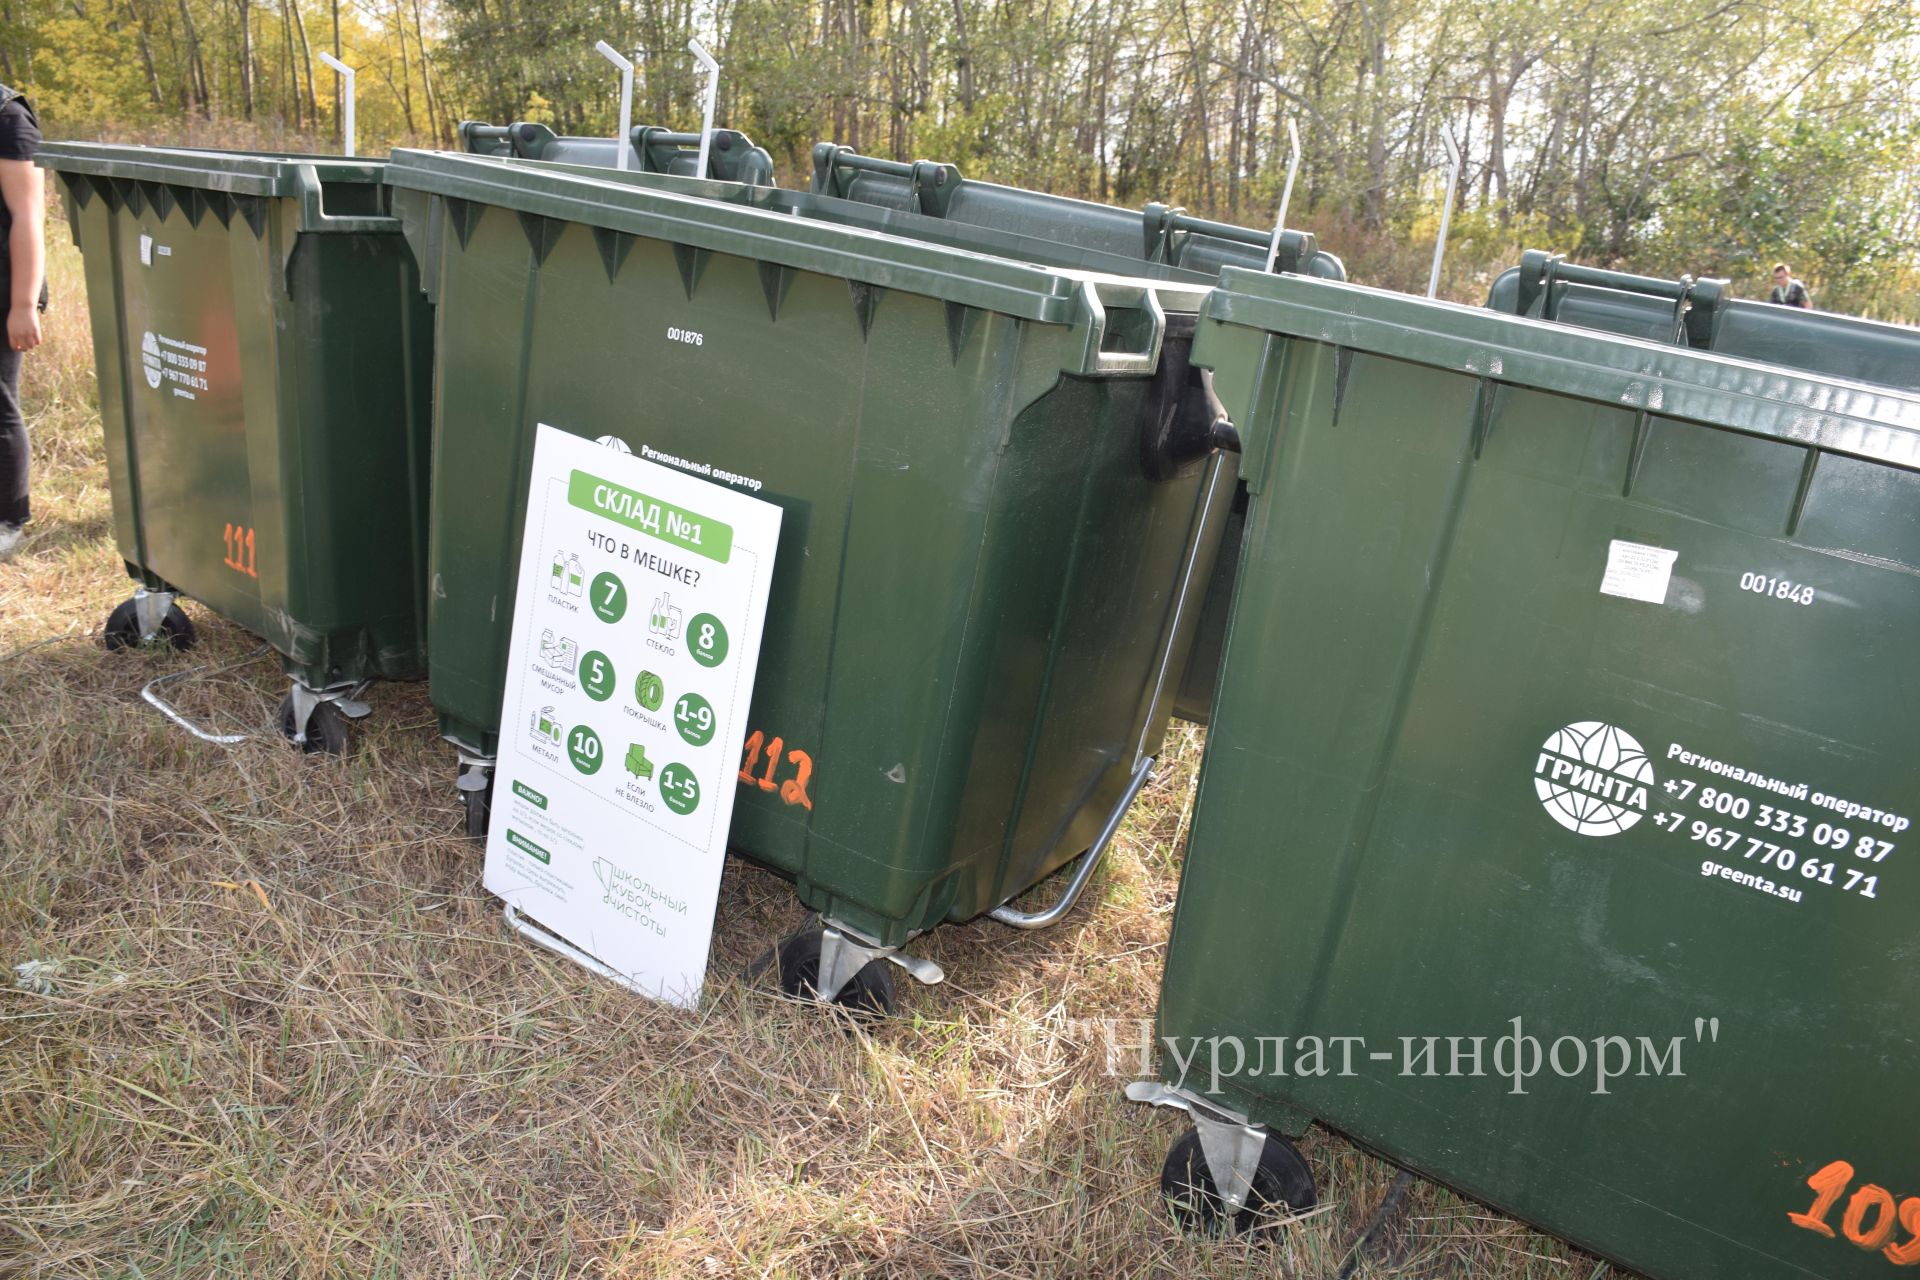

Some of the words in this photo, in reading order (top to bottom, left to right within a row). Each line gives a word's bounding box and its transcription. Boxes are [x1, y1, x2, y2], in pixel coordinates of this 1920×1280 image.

[667, 327, 704, 346] 001876
[642, 444, 711, 476] Региональный
[712, 466, 762, 492] оператор
[594, 484, 661, 534] СКЛАД
[666, 511, 702, 545] №1
[224, 522, 257, 578] 111
[588, 530, 616, 554] ЧТО
[620, 542, 629, 560] В
[634, 546, 700, 588] МЕШКЕ?
[604, 581, 618, 605] 7
[1740, 572, 1815, 606] 001848
[548, 594, 580, 614] ПЛАСТИК
[646, 638, 675, 657] СТЕКЛО
[699, 624, 715, 649] 8
[532, 663, 576, 691] СМЕШАННЫЙ
[590, 659, 604, 683] 5
[541, 680, 564, 696] МУСОР
[624, 705, 667, 732] ПОКРЫШКА
[677, 700, 712, 731] 1-9
[532, 744, 559, 764] МЕТАЛЛ
[573, 732, 598, 759] 10
[664, 770, 695, 799] 1-5
[739, 730, 813, 811] 112
[1535, 752, 1648, 811] ГРИНТА
[518, 786, 542, 805] ВАЖНО!
[616, 788, 625, 798] НЕ
[626, 792, 654, 813] ВЛЕЗЛО
[627, 782, 646, 796] ЕСЛИ
[1668, 743, 1808, 801] Региональный
[1810, 790, 1910, 832] оператор
[1663, 778, 1698, 801] +7
[1698, 788, 1750, 820] 800
[1754, 804, 1808, 838] 333
[1812, 822, 1850, 850] 09
[1854, 836, 1894, 864] 87
[1653, 810, 1686, 834] +7
[1690, 821, 1740, 851] 967
[1745, 838, 1796, 871] 770
[1800, 858, 1836, 886] 61
[1842, 870, 1878, 898] 71
[614, 866, 687, 916] ШКОЛЬНЫЙ
[1700, 860, 1802, 903] greenta.su
[612, 882, 652, 912] КУБОК
[609, 898, 666, 937] ЧИСТОТЫ
